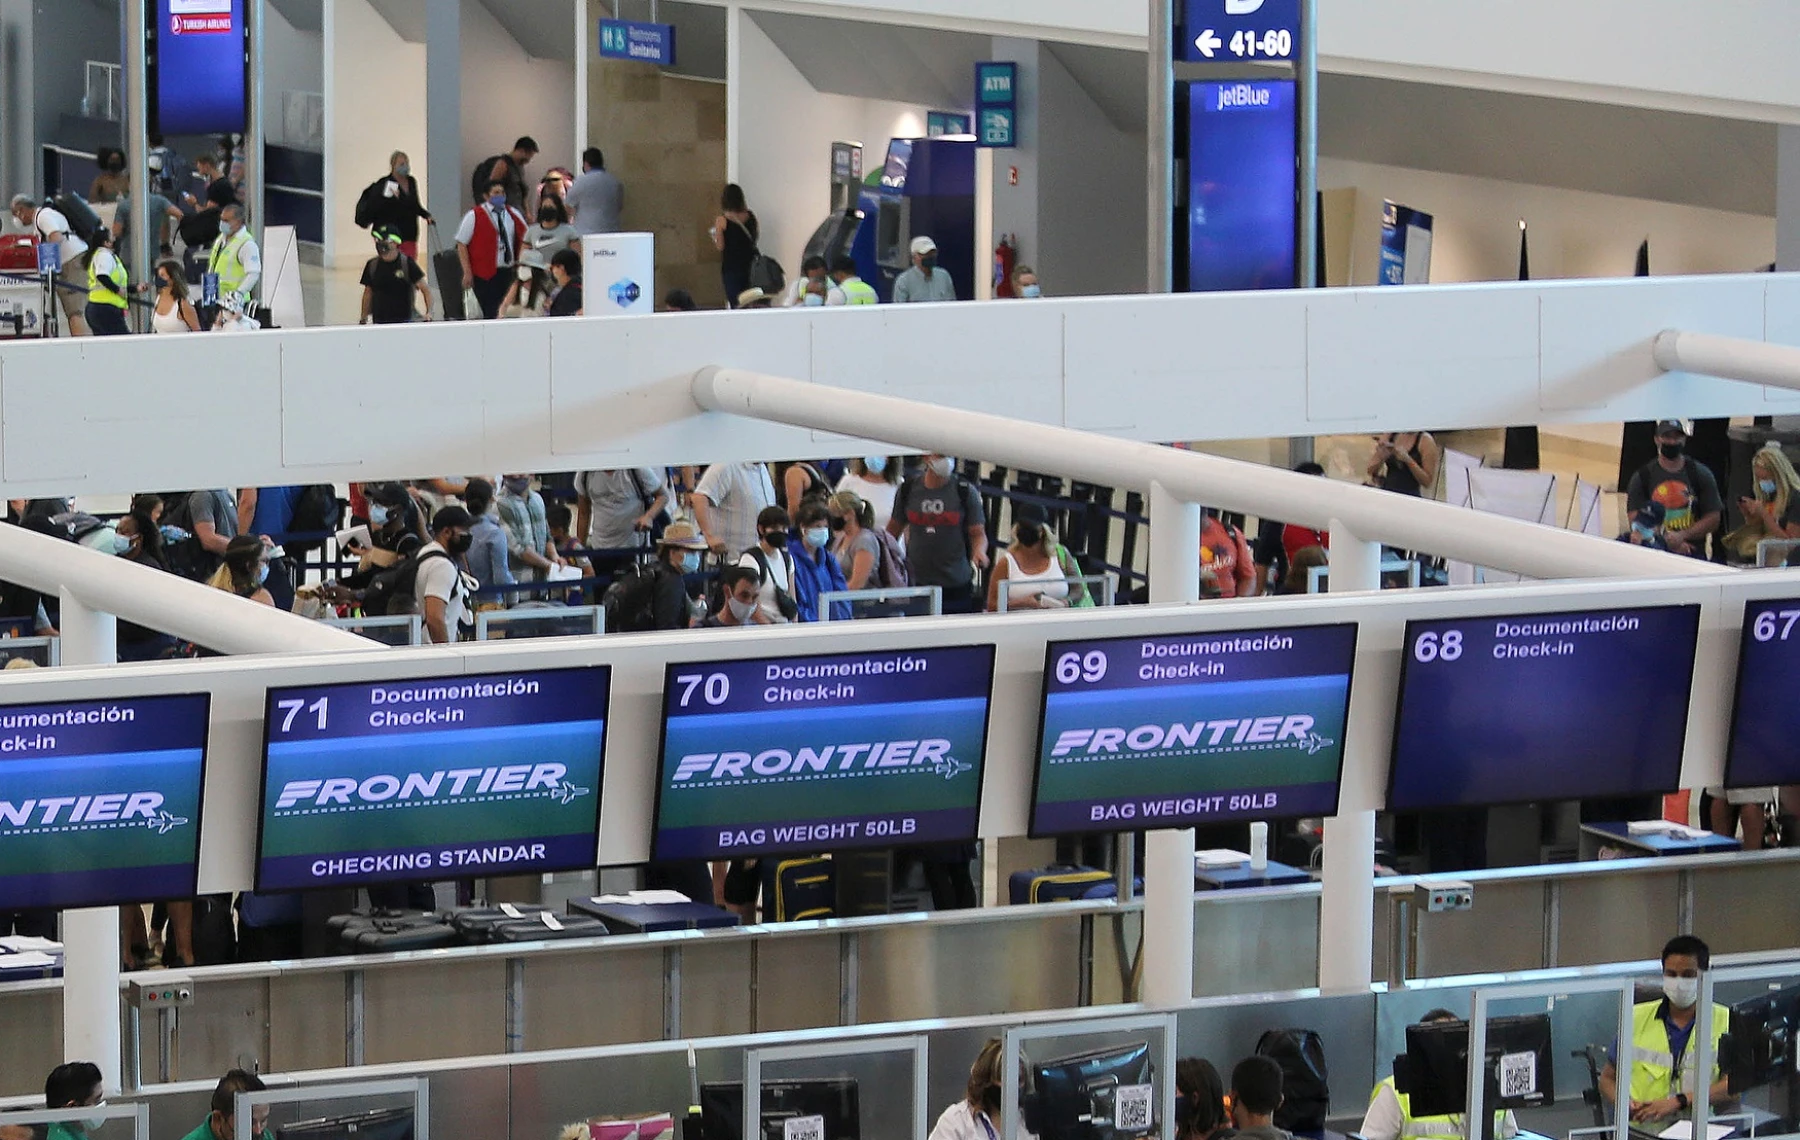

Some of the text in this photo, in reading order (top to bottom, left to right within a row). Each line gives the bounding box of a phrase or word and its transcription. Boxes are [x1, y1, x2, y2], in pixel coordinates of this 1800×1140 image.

[1229, 29, 1292, 57] 41-60
[984, 76, 1011, 92] ATM
[1217, 84, 1270, 111] jetBlue
[1495, 615, 1640, 638] Documentación
[1753, 609, 1800, 642] 67
[1141, 635, 1293, 659] Documentación
[1414, 629, 1463, 663] 68
[1493, 640, 1575, 659] Check-in
[766, 656, 927, 681] Documentación
[1056, 650, 1108, 684] 69
[1139, 660, 1225, 680] Check-in
[370, 679, 539, 706] Documentación
[677, 672, 730, 707] 70
[764, 682, 855, 703] Check-in
[278, 697, 329, 732] 71
[369, 707, 464, 728] Check-in
[1051, 714, 1315, 756] FRONTIER
[672, 738, 951, 781] FRONTIER
[275, 762, 567, 809] FRONTIER
[1090, 793, 1277, 821] BAG WEIGHT 50LB
[719, 818, 917, 847] BAG WEIGHT 50LB
[311, 843, 546, 877] CHECKING STANDAR
